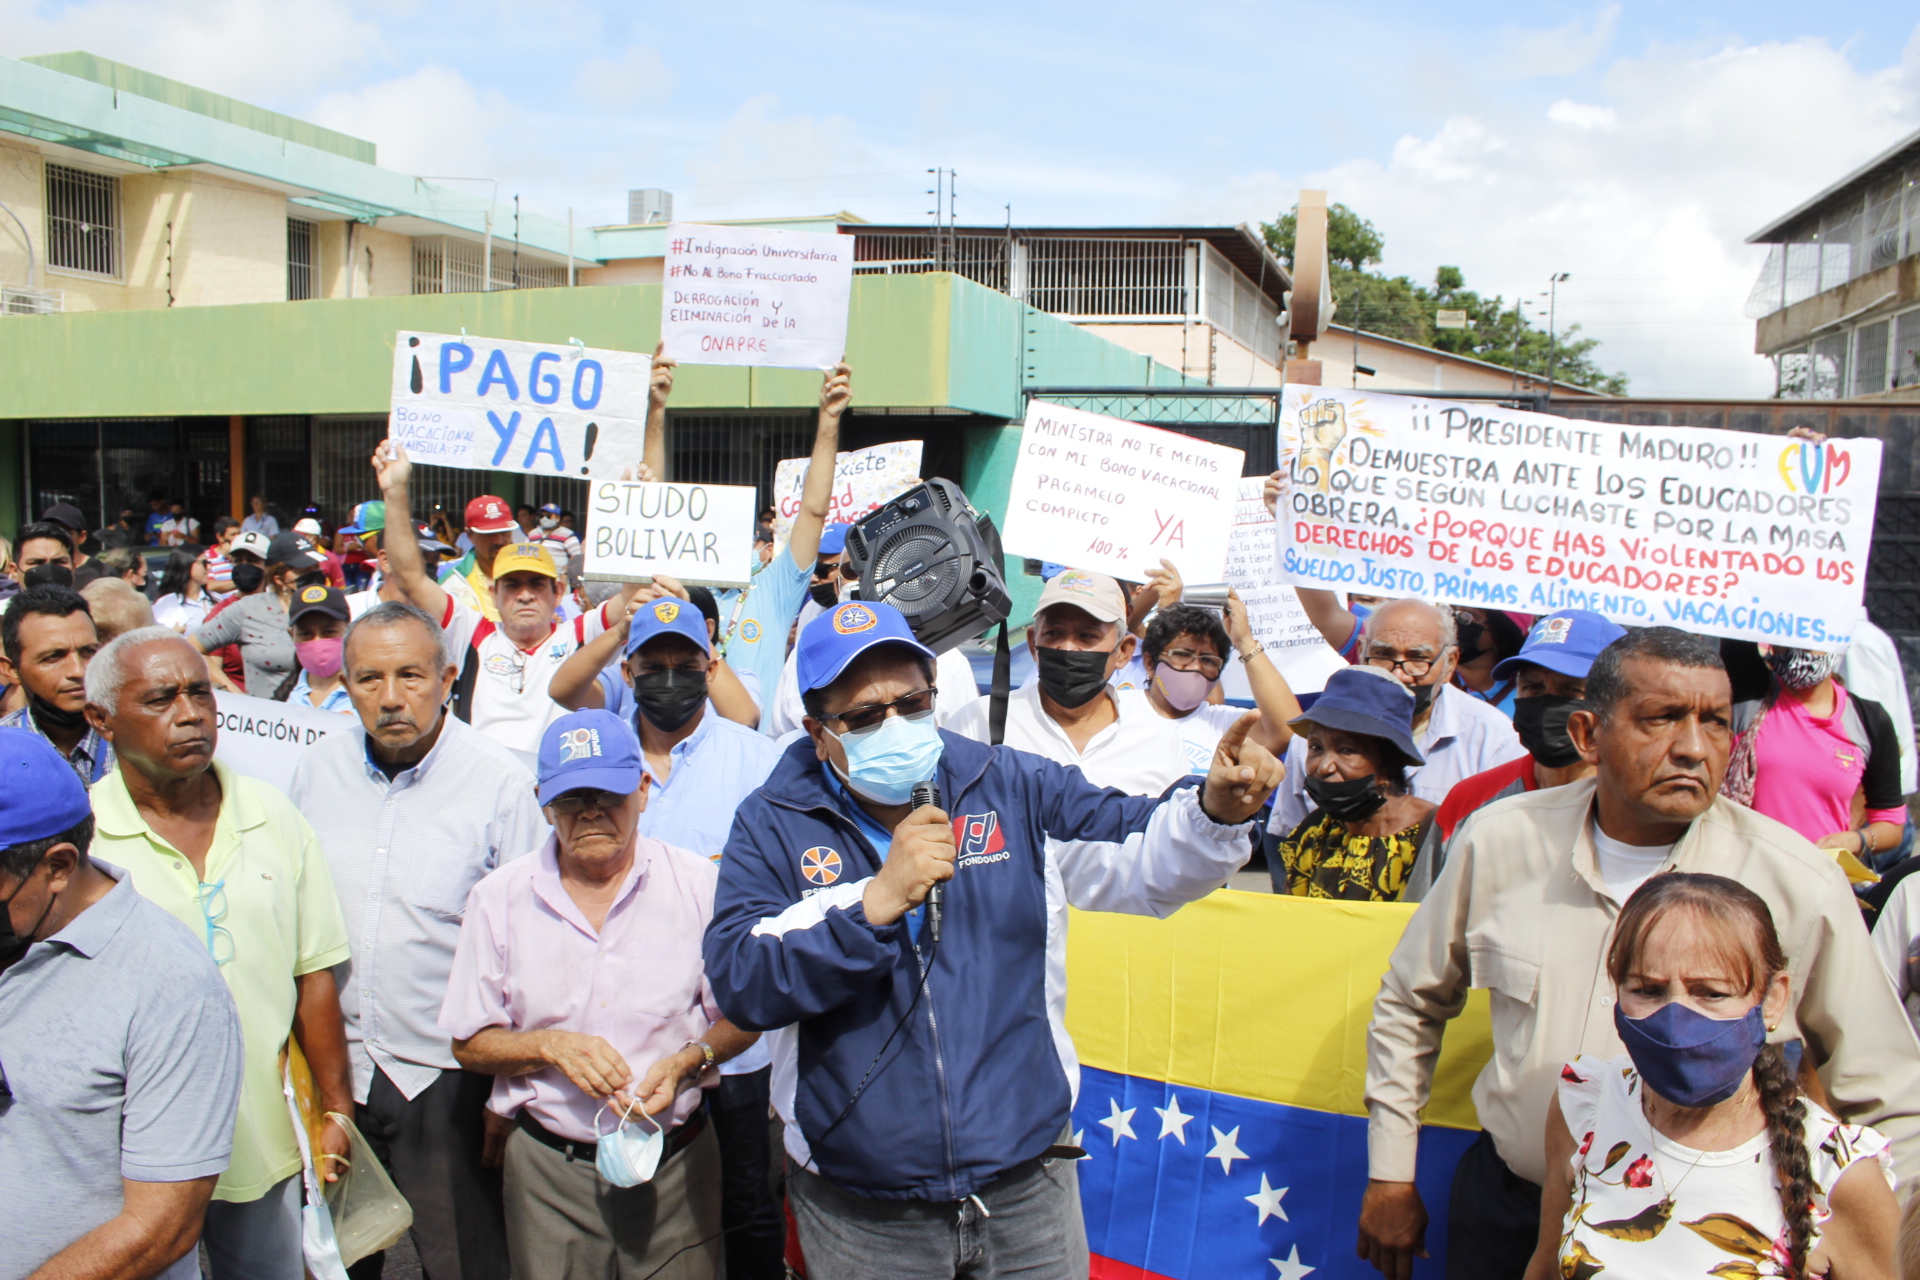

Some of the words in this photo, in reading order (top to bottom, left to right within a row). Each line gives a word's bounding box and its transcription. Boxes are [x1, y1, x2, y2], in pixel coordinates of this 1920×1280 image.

[762, 245, 838, 262] Universitaria
[717, 267, 743, 280] Bono
[744, 267, 818, 284] Fraccionado
[701, 335, 768, 352] ONAPRE
[1034, 416, 1114, 447] MINISTRA
[1121, 438, 1142, 452] NO
[1149, 442, 1163, 459] TE
[1171, 449, 1218, 473] METAS
[835, 450, 886, 479] xiste
[1028, 442, 1057, 458] CON
[1065, 450, 1088, 467] MI
[1100, 457, 1137, 477] BONO
[1141, 468, 1221, 501] VACACIONAL
[1350, 436, 1500, 483] DEMUESTRA
[1512, 459, 1582, 491] ANTE
[1596, 464, 1647, 500] LOS
[1659, 476, 1852, 526] EDUCADORES
[595, 482, 708, 522] STUDO
[1037, 473, 1126, 505] PAGAMELO
[1289, 456, 1320, 486] LO
[1330, 469, 1388, 497] QUE
[1394, 477, 1486, 510] SEGÚN
[1500, 487, 1640, 530] LUCHASTE
[1653, 511, 1715, 542] POR
[1721, 519, 1759, 546] LA
[1768, 524, 1847, 556] MASA
[596, 525, 720, 564] BOLIVAR
[1150, 508, 1185, 549] YA
[1413, 506, 1546, 550] ¿PORQUE
[1552, 529, 1607, 558] HAS
[1816, 556, 1855, 586] LOS
[1282, 546, 1356, 583] SUELDO
[1294, 521, 1415, 558] DERECHOS
[1428, 540, 1462, 564] DE
[1470, 545, 1515, 572] LOS
[1525, 554, 1740, 600] EDUCADORES?
[1243, 593, 1279, 606] amente
[1263, 635, 1326, 651] vacaciona
[958, 850, 1010, 869] FONDOUDO
